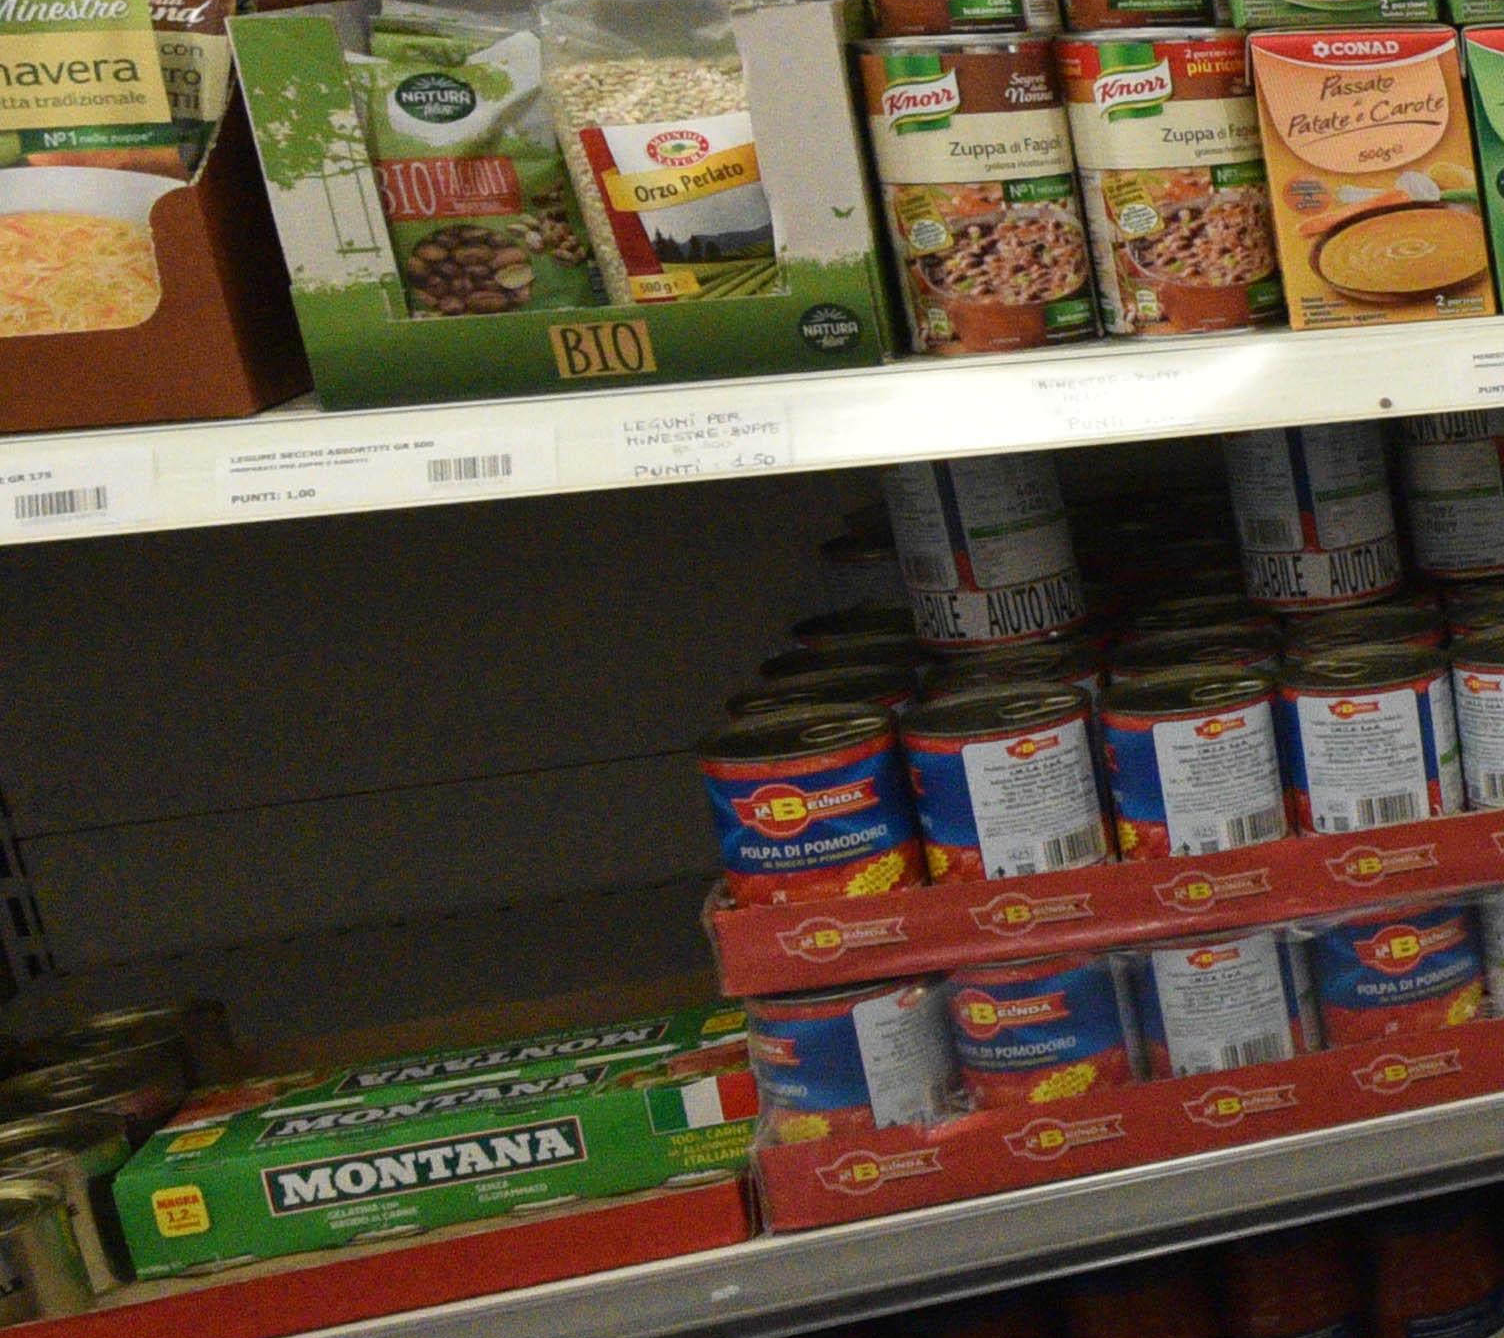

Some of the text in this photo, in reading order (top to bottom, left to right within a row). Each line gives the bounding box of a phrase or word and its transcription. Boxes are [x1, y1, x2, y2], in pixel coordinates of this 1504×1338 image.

[1329, 40, 1399, 56] CONAD
[35, 90, 146, 109] tradizionale
[400, 89, 471, 107] NATURA
[884, 87, 954, 115] Knorr
[1320, 74, 1395, 101] Passato
[1288, 95, 1444, 138] Patate Carote
[950, 140, 1006, 159] Zuppa
[1161, 128, 1214, 145] Zuppa
[635, 162, 745, 202] Orzo Perlato
[803, 322, 857, 338] NATURA
[561, 323, 645, 376] BIO
[740, 824, 887, 860] POLPA DI POMODORO
[275, 1069, 594, 1135] MONTANA
[279, 1128, 574, 1207] MONTANA
